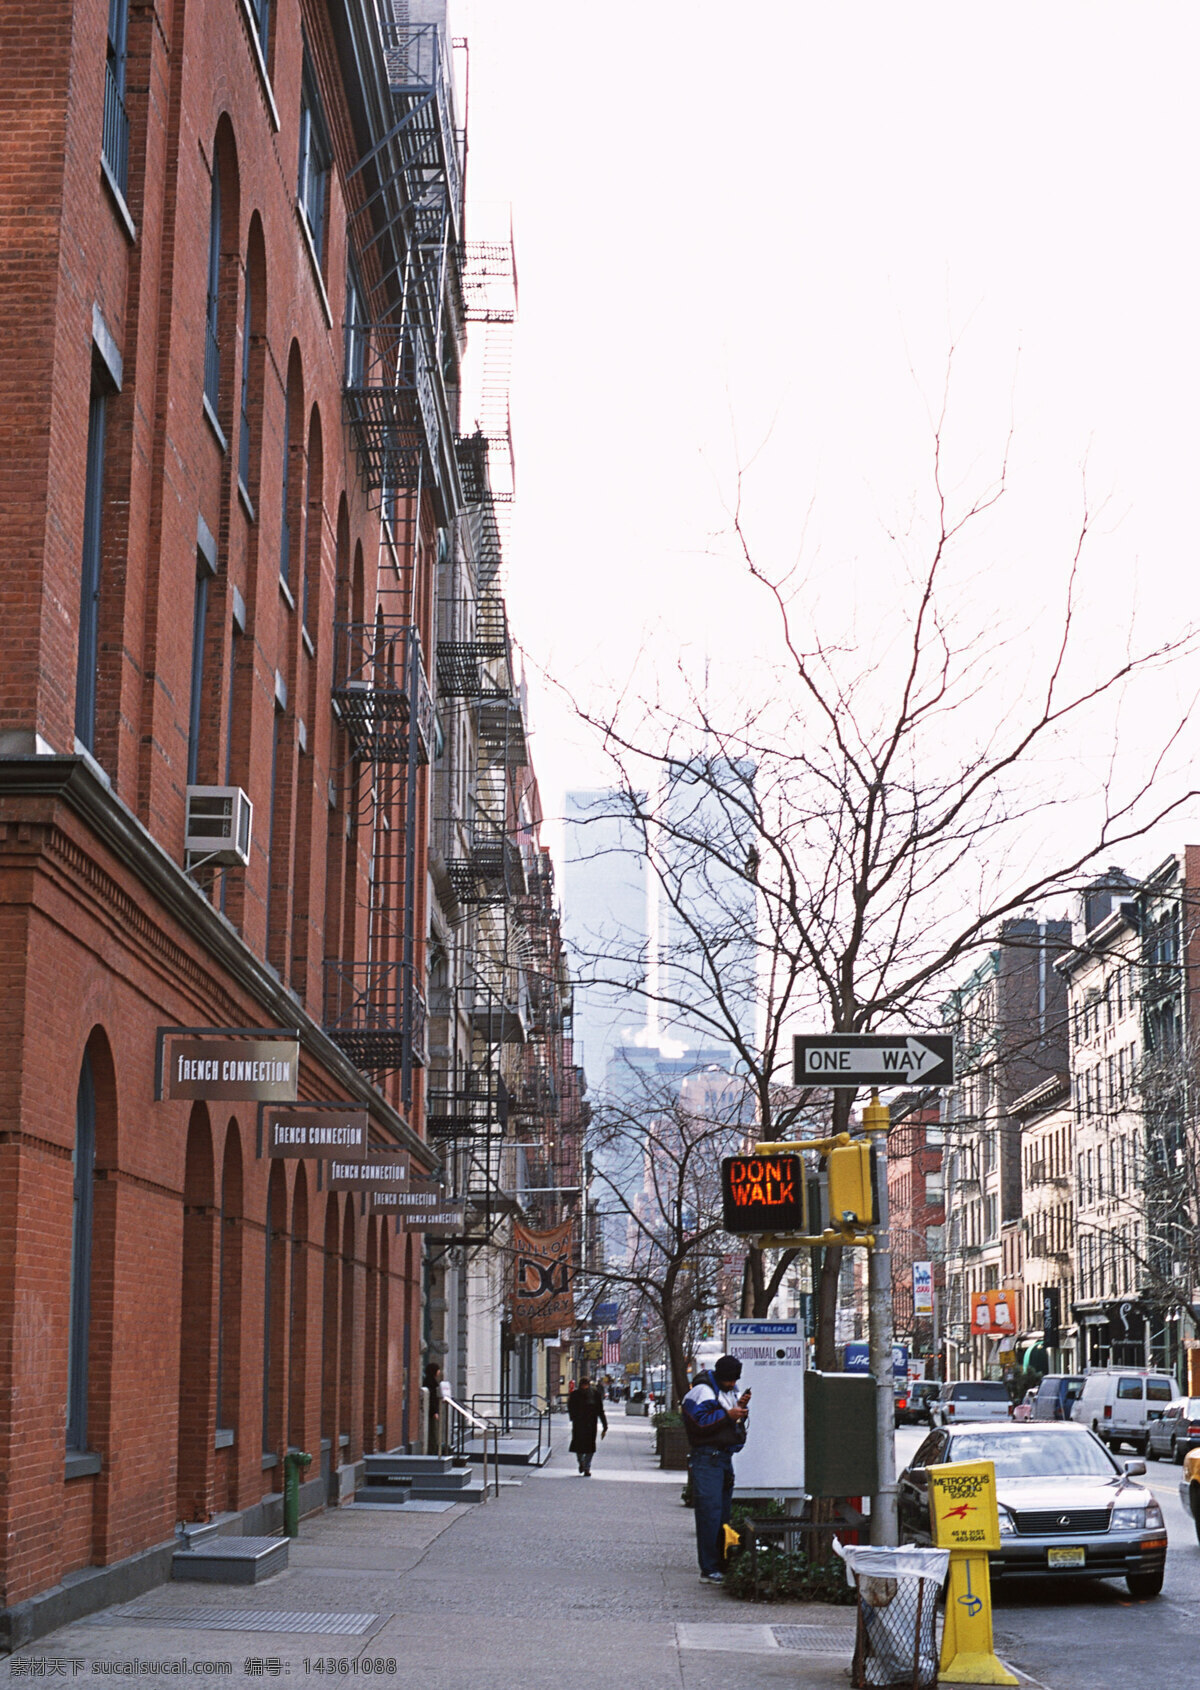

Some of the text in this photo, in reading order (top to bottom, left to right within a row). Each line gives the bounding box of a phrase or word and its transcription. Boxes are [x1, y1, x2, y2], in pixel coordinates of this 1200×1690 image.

[809, 1051, 927, 1070] ONE WAY
[731, 1159, 793, 1183] DONT
[731, 1182, 794, 1206] WALK
[516, 1299, 569, 1317] GALLERY
[730, 1323, 796, 1334] TCC TELEPLEX
[934, 1475, 990, 1486] METROPOLIS
[943, 1483, 983, 1494] FENCING
